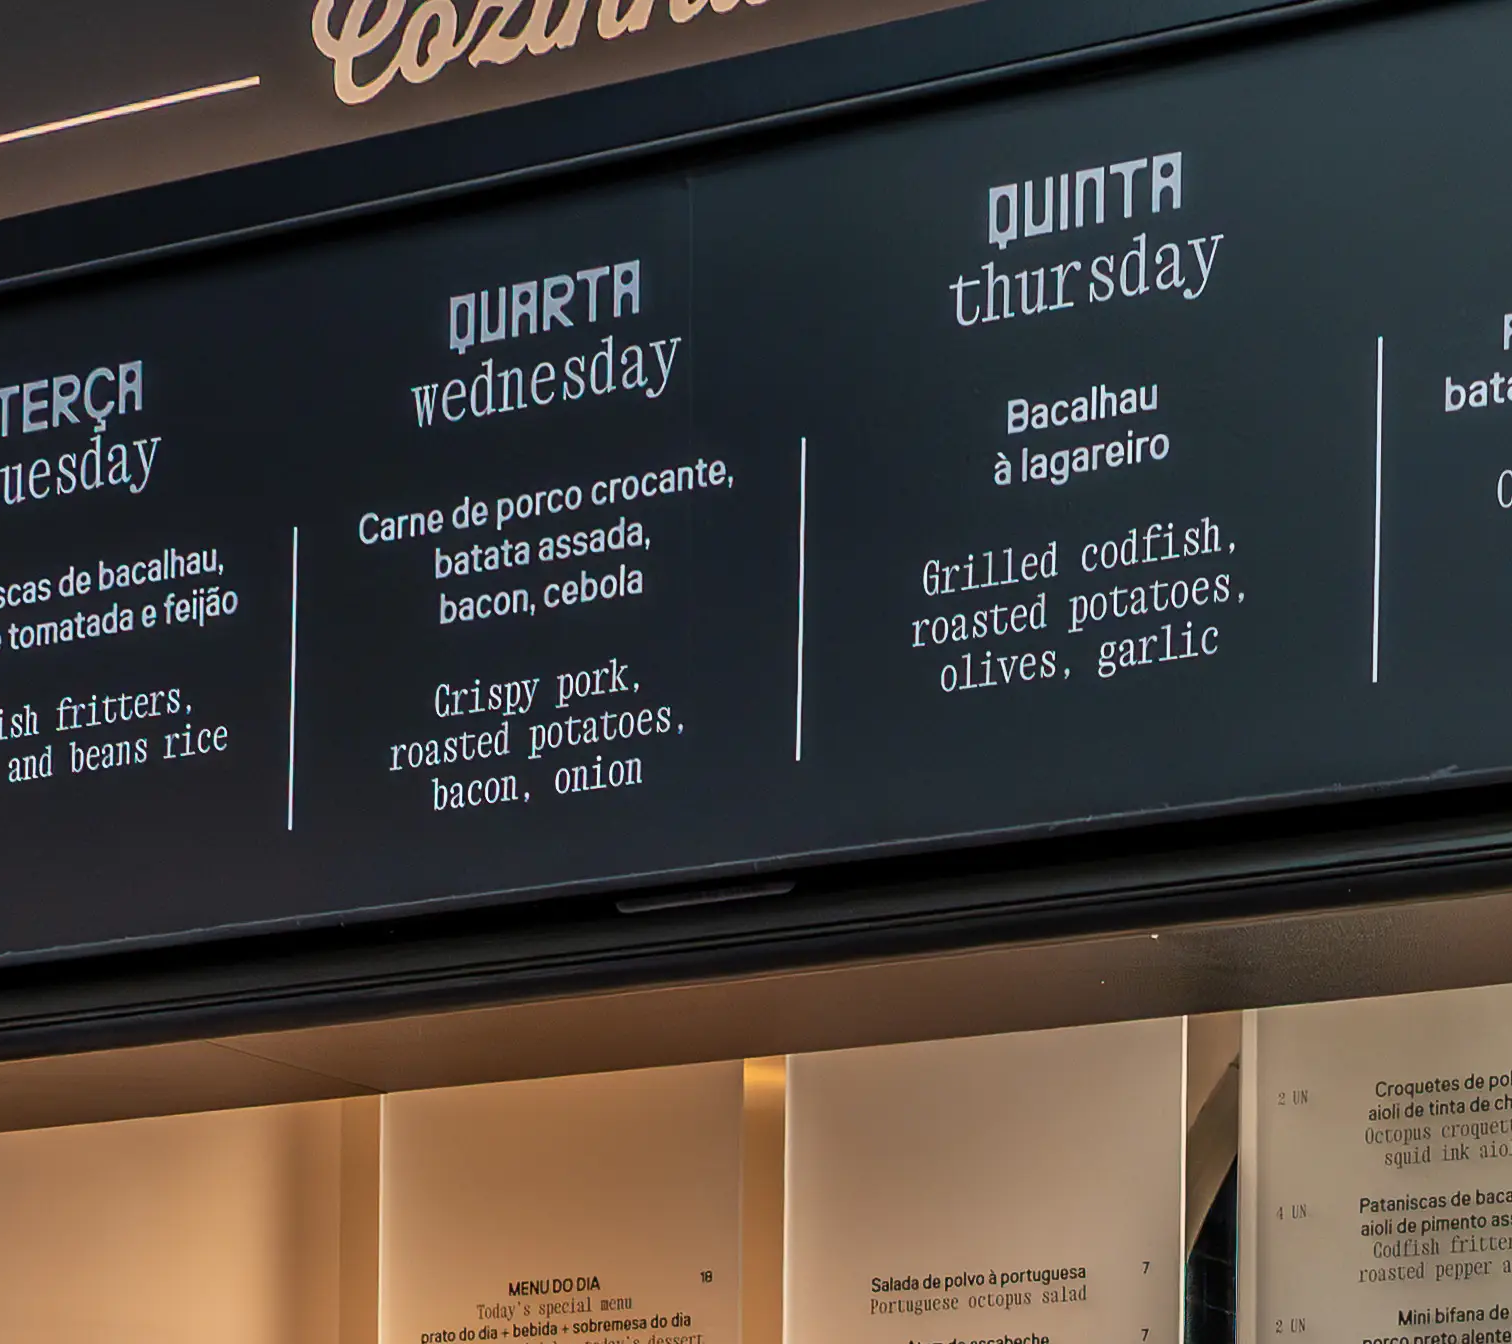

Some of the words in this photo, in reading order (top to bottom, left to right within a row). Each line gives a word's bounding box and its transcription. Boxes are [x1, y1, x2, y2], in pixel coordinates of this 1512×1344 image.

[989, 151, 1182, 250] QUINTA
[450, 259, 640, 355] QUARTA
[949, 232, 1224, 326] thursday
[411, 335, 682, 428] wednesday
[1008, 384, 1157, 434] Bacalhau
[994, 452, 1011, 485] à
[1022, 430, 1169, 485] lagareiro
[359, 510, 443, 544] Carne
[452, 496, 488, 529] de
[497, 486, 582, 531] porco
[591, 458, 733, 505] crocante,
[59, 566, 91, 597] de
[99, 548, 223, 591] bacalhau,
[435, 539, 530, 579] batata
[538, 516, 650, 561] assada,
[8, 603, 133, 650] tomatada
[142, 605, 156, 628] e
[163, 586, 238, 627] feijão
[440, 589, 535, 624] bacon,
[544, 564, 642, 608] cebola
[1376, 1078, 1460, 1099] Croquetes
[1464, 1073, 1484, 1090] de
[509, 1279, 549, 1296] MENU
[553, 1278, 573, 1293] DO
[576, 1276, 600, 1291] DIA
[700, 1270, 713, 1283] 18
[872, 1276, 919, 1293] Salada
[923, 1274, 941, 1289] de
[945, 1272, 984, 1292] polvo
[989, 1269, 997, 1285] à
[1001, 1267, 1086, 1288] portuguesa
[1142, 1261, 1150, 1274] 7
